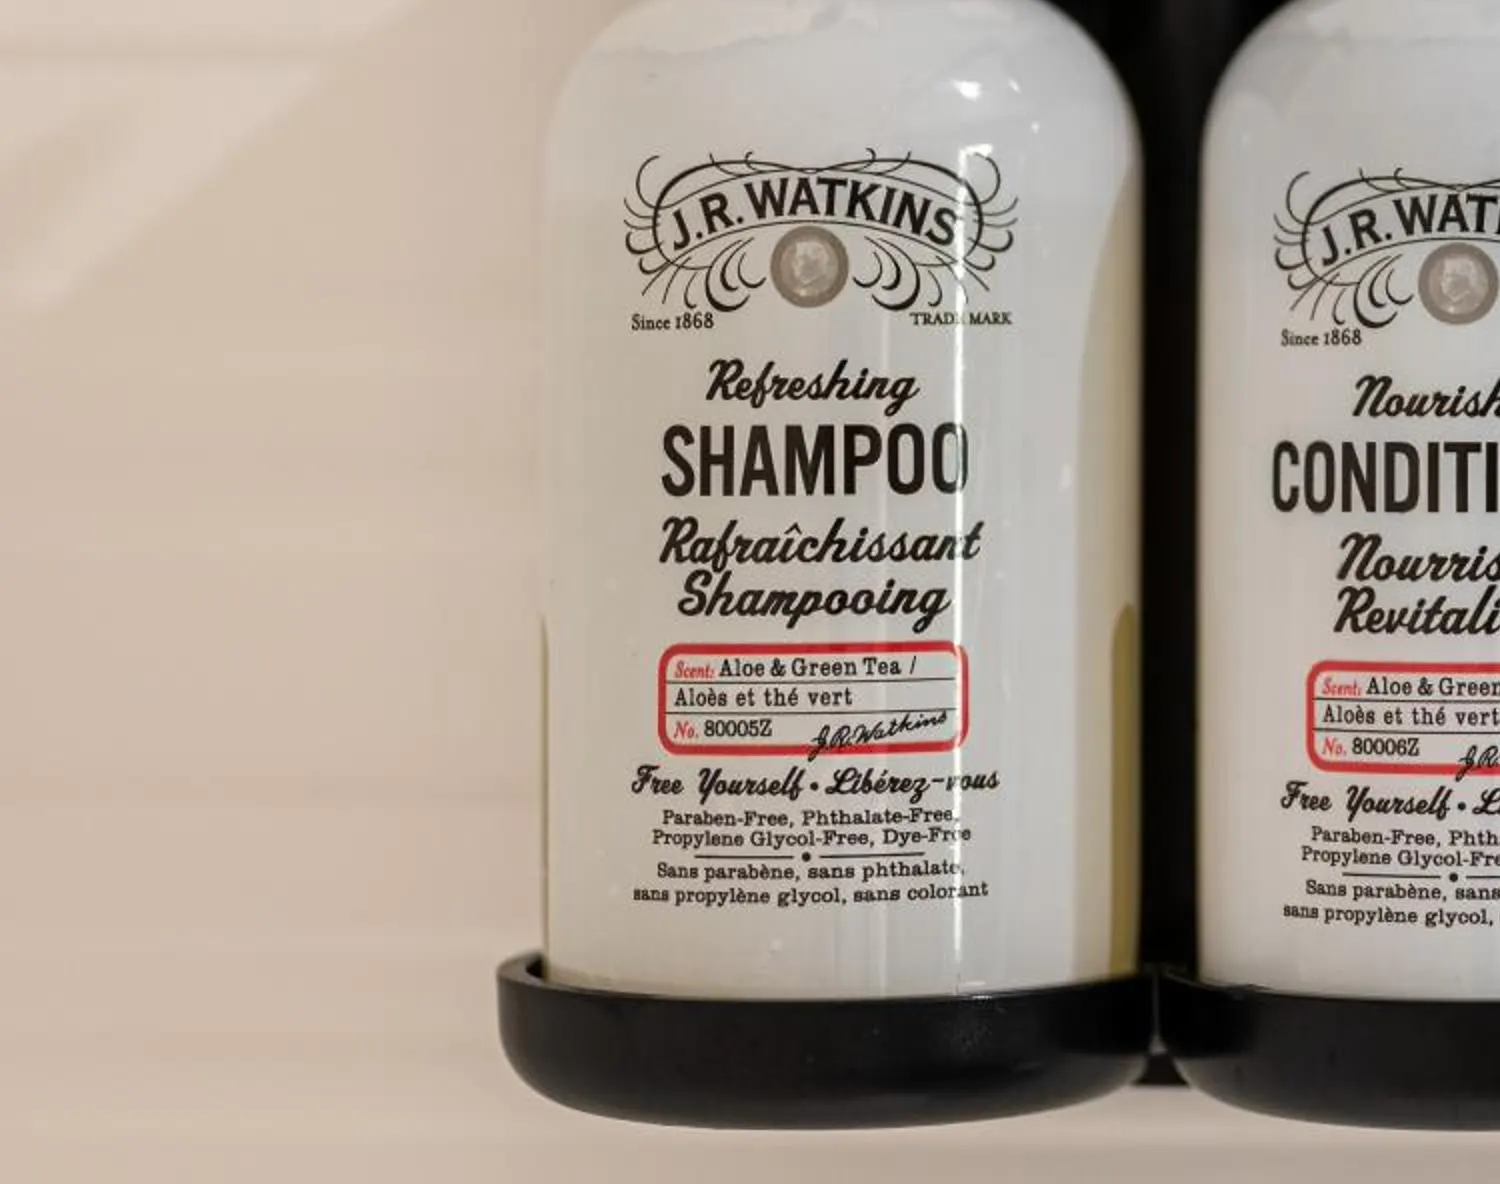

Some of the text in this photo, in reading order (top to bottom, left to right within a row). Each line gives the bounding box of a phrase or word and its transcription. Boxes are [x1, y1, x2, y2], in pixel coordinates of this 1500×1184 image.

[670, 177, 959, 251] J.R. WATKINS
[1320, 208, 1392, 267] J.R.
[631, 313, 714, 330] Since 1868
[909, 311, 1012, 327] TRAD MARK
[1280, 329, 1362, 347] Since 1868
[705, 358, 921, 417] Refreshing
[661, 421, 969, 497] SHAMPOO
[658, 516, 985, 572] Rafraîchissant
[677, 569, 952, 633] Shampooing
[673, 660, 715, 680] Scent:
[718, 658, 765, 678] Aloe
[769, 659, 786, 677] &
[791, 657, 858, 677] Green
[863, 656, 902, 675] Tea
[673, 686, 853, 708] Aloès et thé vert
[1321, 677, 1363, 697] Scent:
[1366, 677, 1413, 696] Aloe
[1418, 678, 1434, 696] &
[1322, 705, 1500, 727] Aloès et thé vert
[672, 719, 773, 739] No. 80005Z
[1321, 737, 1420, 756] No. 80006Z
[631, 764, 684, 796] Free
[698, 766, 805, 805] Yourself
[1280, 780, 1333, 813] Free
[1346, 786, 1451, 822] Yourself
[662, 809, 794, 829] Paraben-Free,
[651, 828, 972, 850] Propylene Glycol-Free, Dye-Free
[1310, 826, 1441, 847] Paraben-Free,
[1301, 846, 1392, 867] Propylene
[656, 862, 699, 880] Sans
[704, 862, 800, 886] parabène,
[807, 864, 855, 880] sans
[632, 881, 989, 907] sans propylène glycol, sans colorant
[1305, 880, 1348, 897] Sans
[1352, 883, 1448, 905] parabène,
[1282, 904, 1320, 920] sans
[1323, 906, 1418, 927] propylène
[1425, 907, 1494, 928] glycol,
